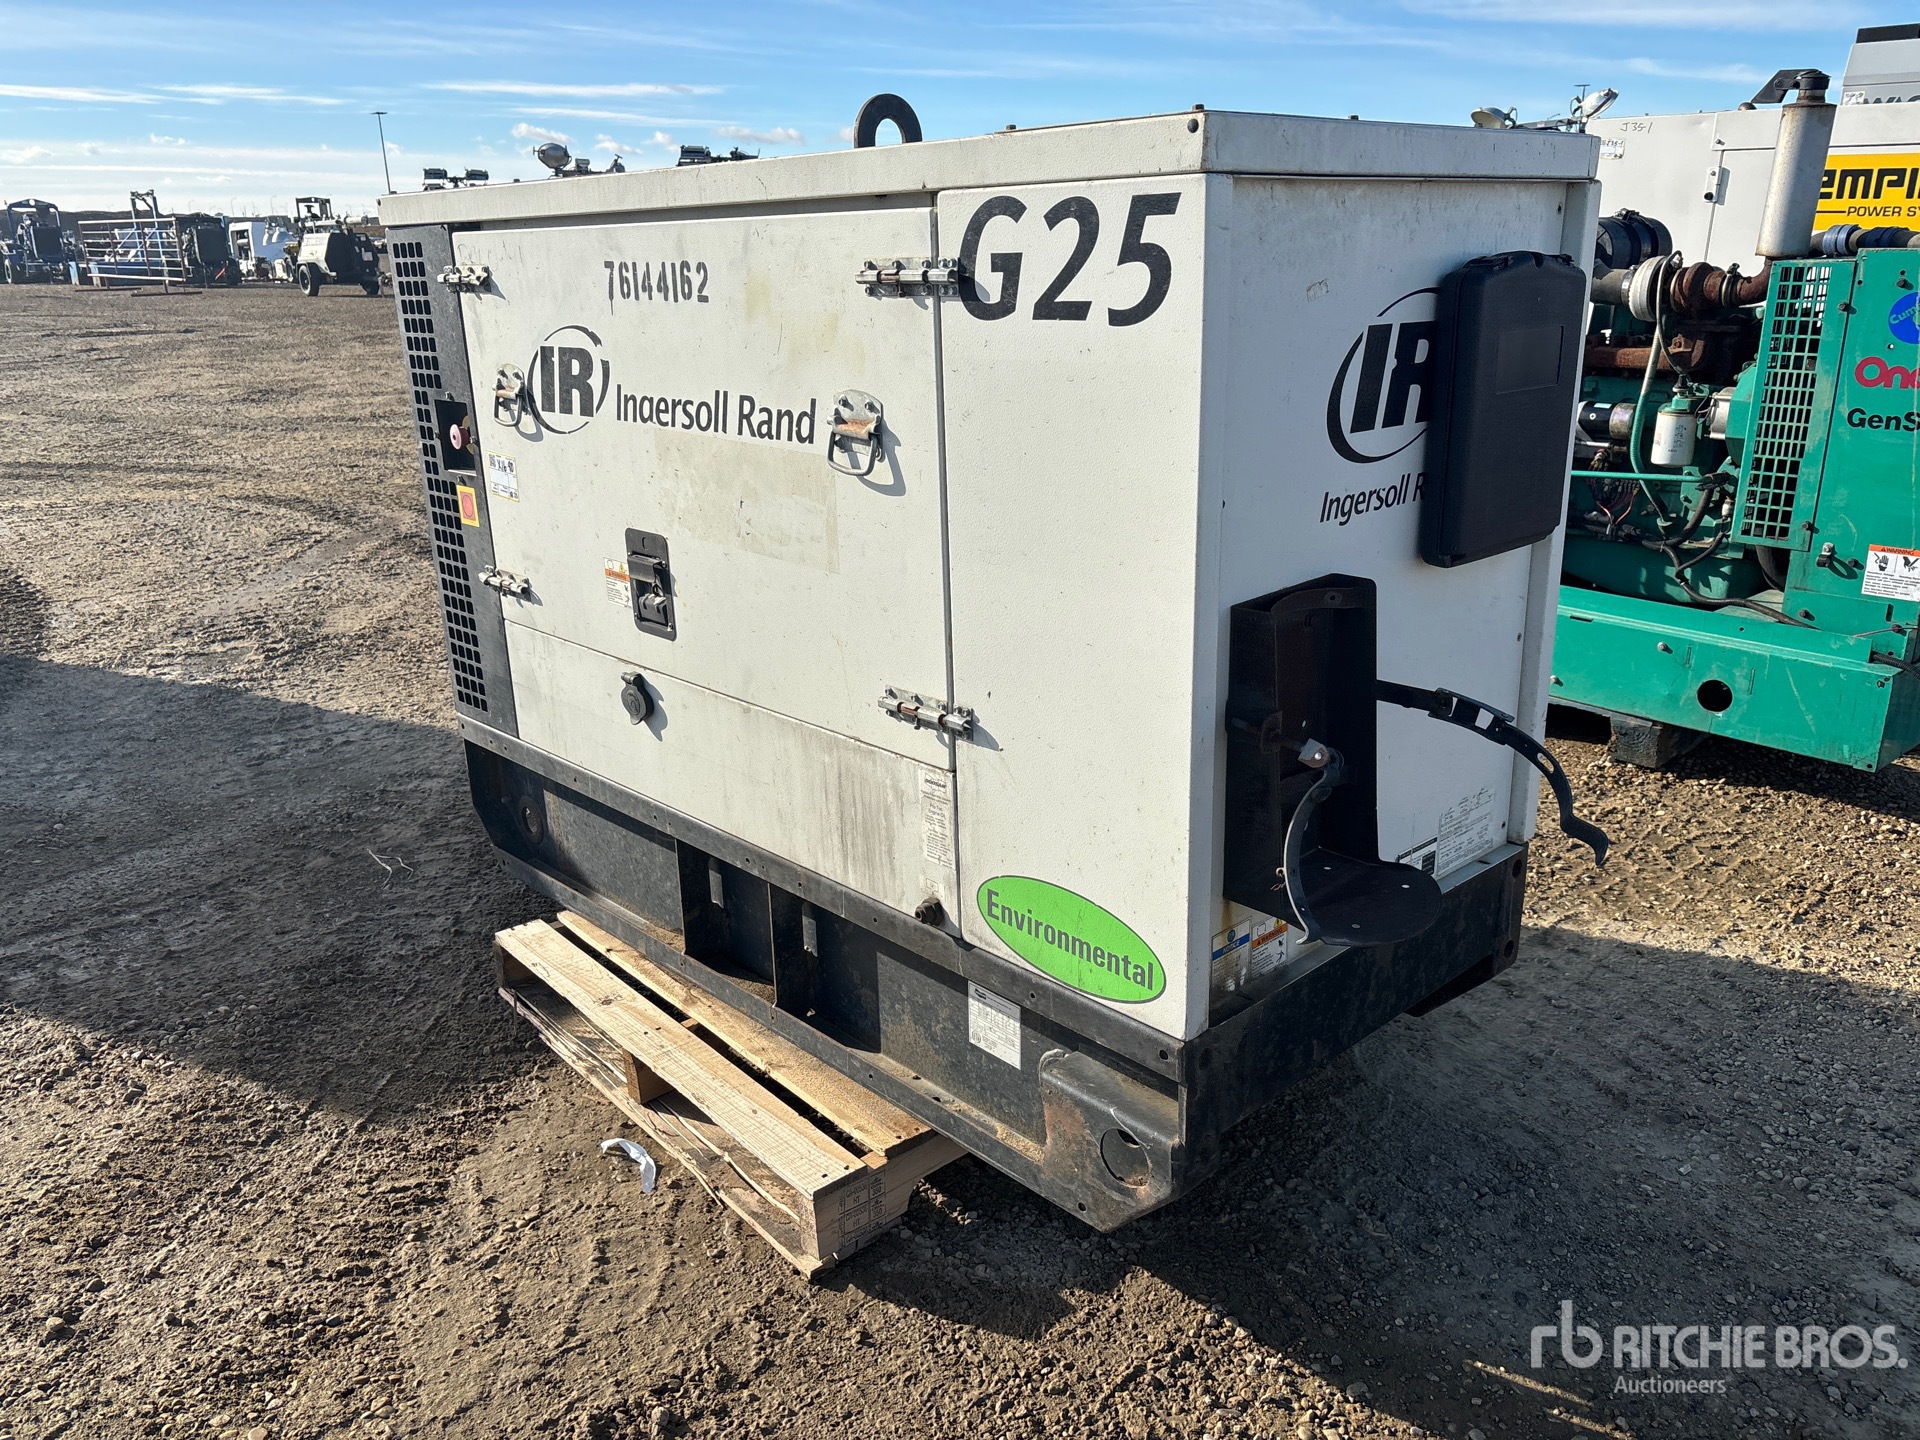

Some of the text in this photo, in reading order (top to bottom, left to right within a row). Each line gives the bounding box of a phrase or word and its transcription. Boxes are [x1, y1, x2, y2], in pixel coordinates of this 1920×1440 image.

[1847, 206, 1902, 217] POWER
[603, 260, 710, 305] 76144162
[959, 192, 1182, 326] G25
[1889, 303, 1920, 325] Cum
[540, 346, 596, 418] IR
[616, 384, 818, 445] Ingersoll Rand
[1319, 474, 1411, 527] Ingersoll
[986, 887, 1155, 990] Environmental
